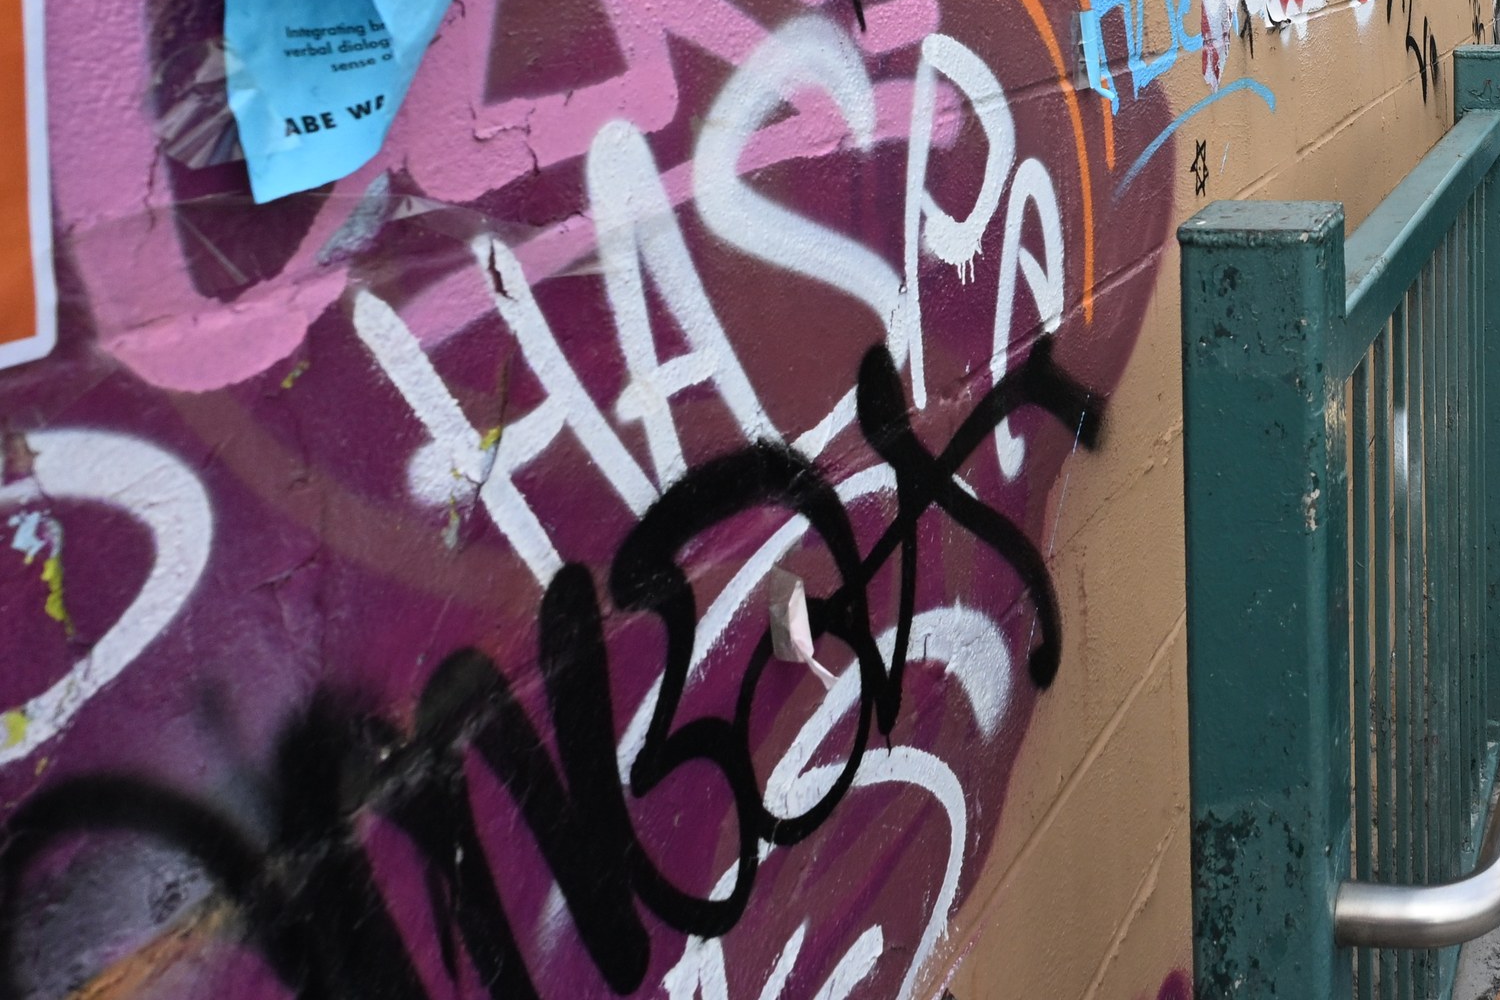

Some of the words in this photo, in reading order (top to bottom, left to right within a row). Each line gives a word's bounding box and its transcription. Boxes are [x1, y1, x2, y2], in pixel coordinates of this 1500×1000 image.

[285, 21, 367, 41] Integrating
[283, 41, 334, 57] verbal
[331, 58, 377, 72] sense
[284, 111, 337, 137] ABE
